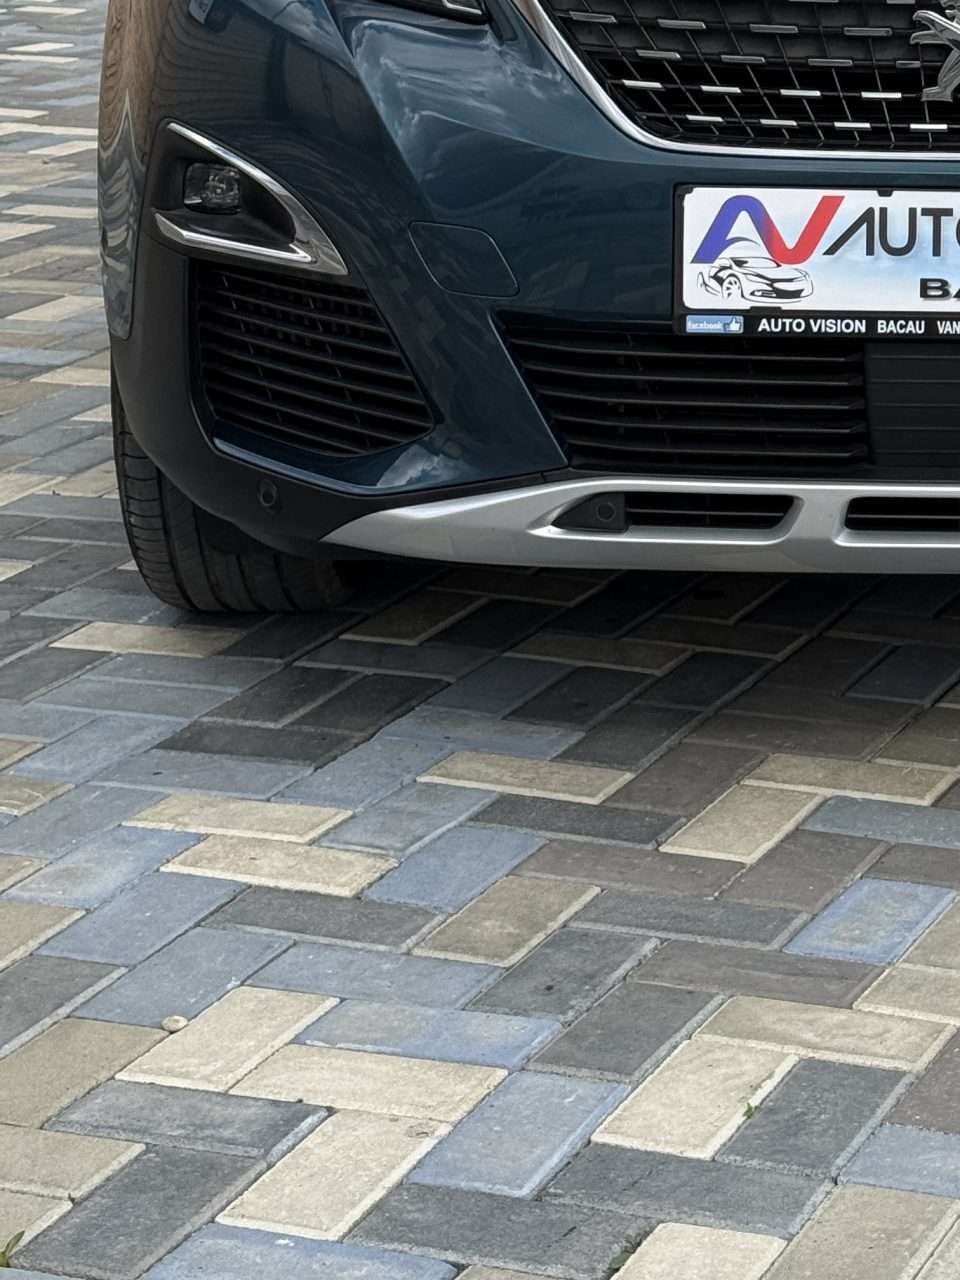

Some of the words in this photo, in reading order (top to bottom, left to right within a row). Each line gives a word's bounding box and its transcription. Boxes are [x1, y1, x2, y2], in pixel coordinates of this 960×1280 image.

[757, 318, 806, 334] AUTO
[809, 318, 867, 334] VISION
[877, 319, 926, 335] BACAU
